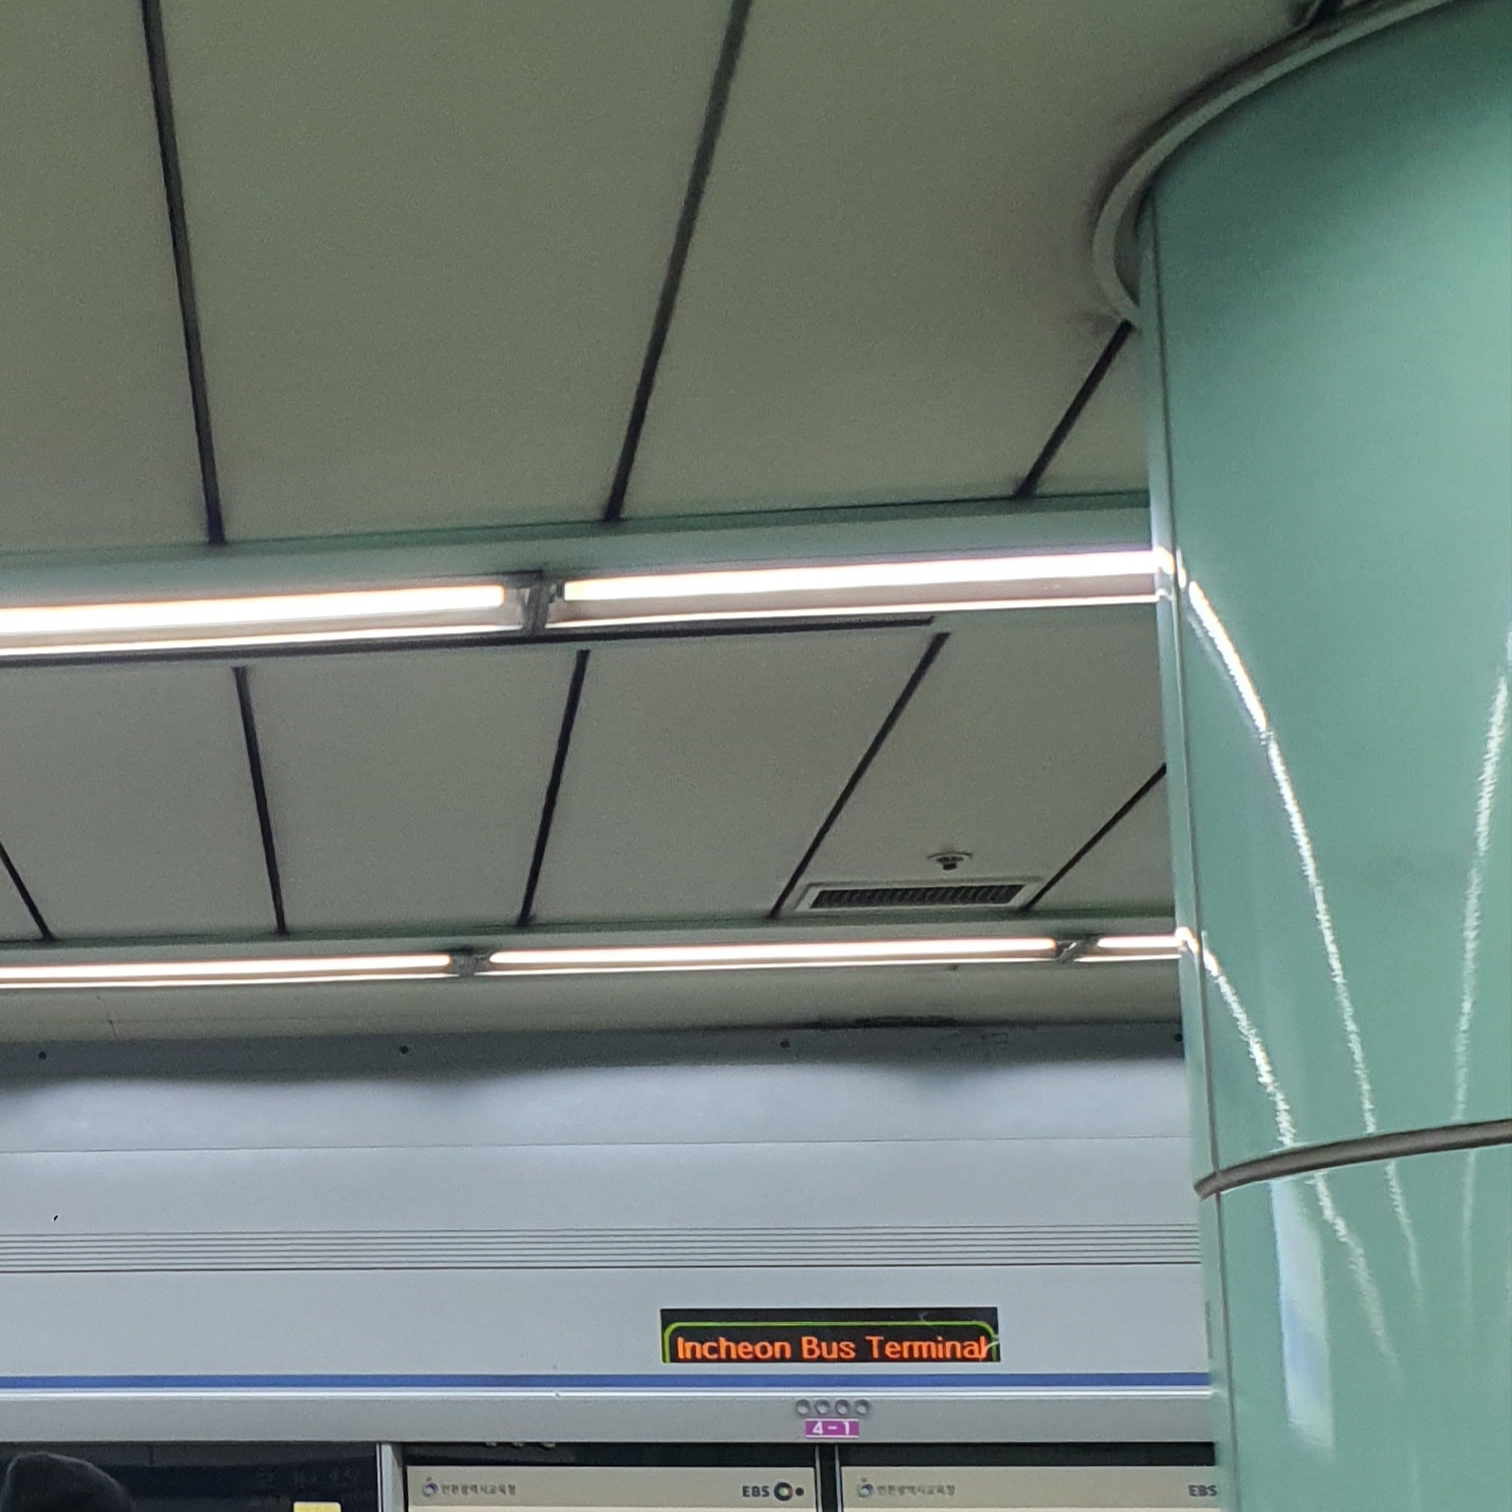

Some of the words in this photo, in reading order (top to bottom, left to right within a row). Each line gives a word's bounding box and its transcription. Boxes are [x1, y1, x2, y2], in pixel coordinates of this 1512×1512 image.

[677, 1336, 789, 1359] Incheon
[801, 1336, 856, 1359] Bus
[866, 1335, 988, 1360] Terminal
[812, 1421, 851, 1435] 4-1
[742, 1485, 770, 1498] EBS
[1188, 1484, 1218, 1497] EBS
